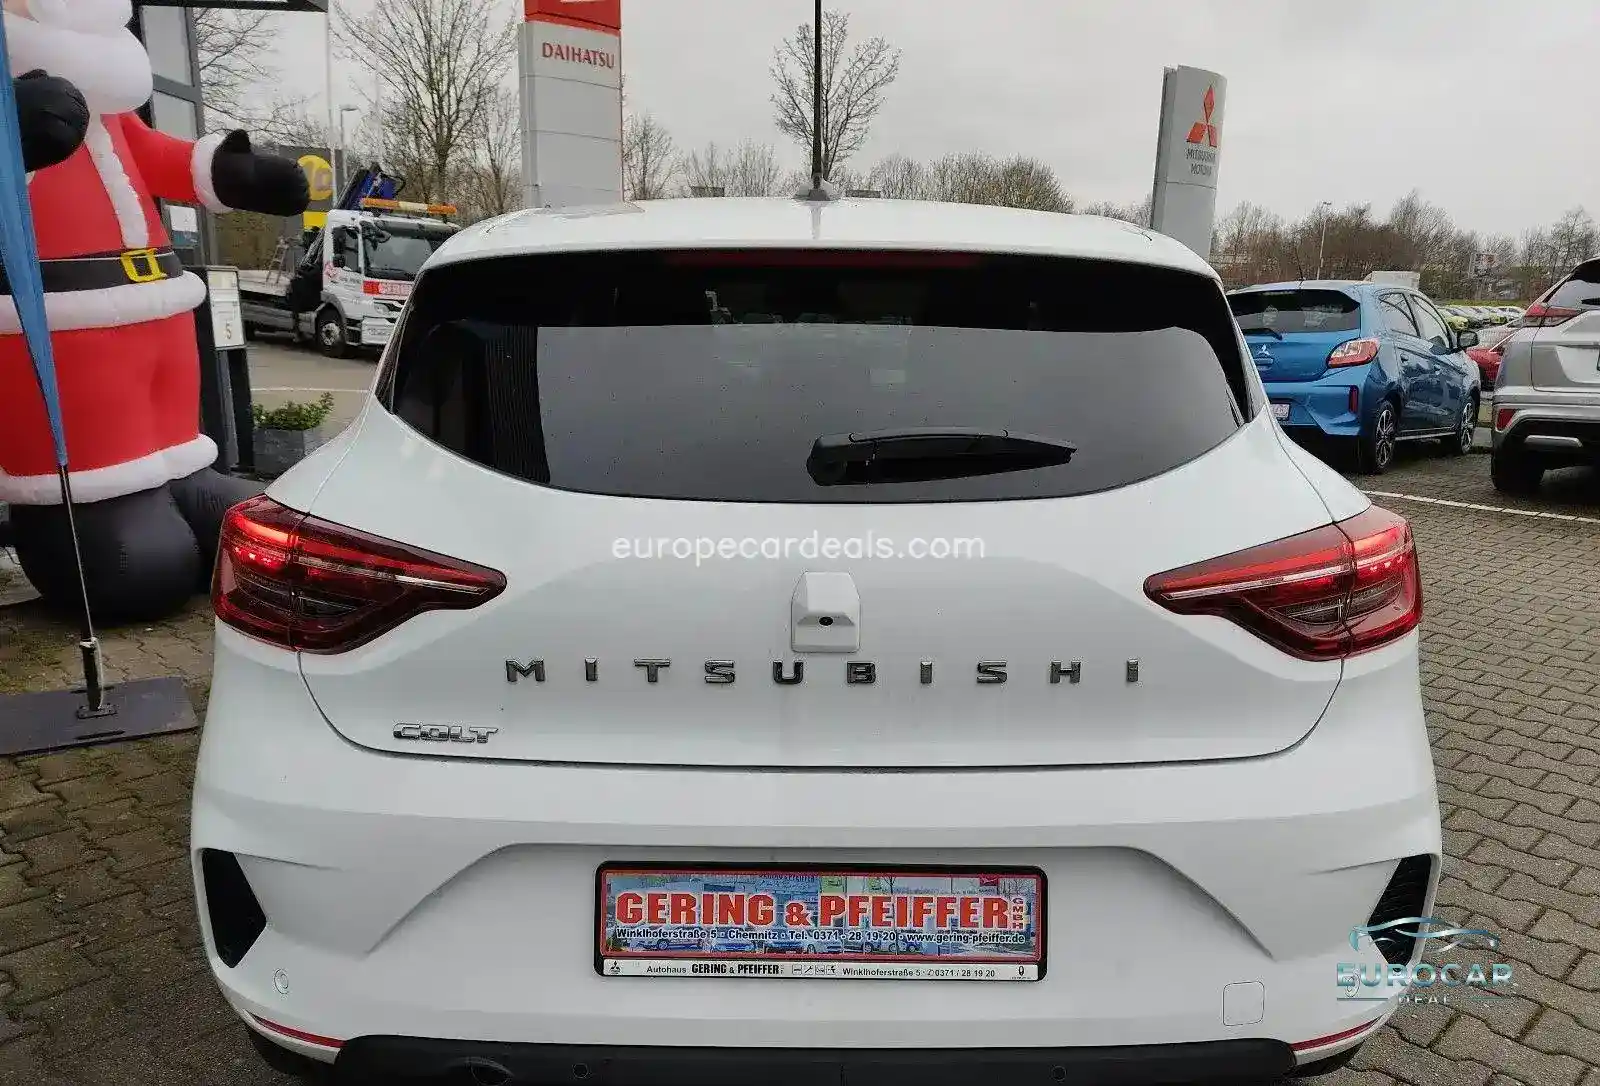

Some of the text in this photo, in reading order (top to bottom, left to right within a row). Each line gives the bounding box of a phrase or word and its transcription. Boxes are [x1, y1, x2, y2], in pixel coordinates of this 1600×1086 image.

[542, 41, 616, 69] DAIHATSU
[504, 656, 1141, 685] MITSUBISHI
[392, 722, 499, 744] COLT
[615, 892, 1009, 930] GERING & PFEIFFER
[616, 928, 1026, 944] Winklhoferstraße 5 Chemnitz Tel. 0371 28 19 20 www.gering-pfeiffer.de
[646, 965, 687, 974] Autohaus
[691, 964, 727, 975] GERING
[729, 966, 736, 975] &
[737, 964, 780, 975] PFEIFFER
[842, 967, 914, 977] Winklhoferstraße
[915, 967, 922, 977] 5
[934, 968, 956, 978] 0371
[961, 969, 972, 978] 28
[973, 969, 984, 978] 19
[985, 969, 996, 978] 20
